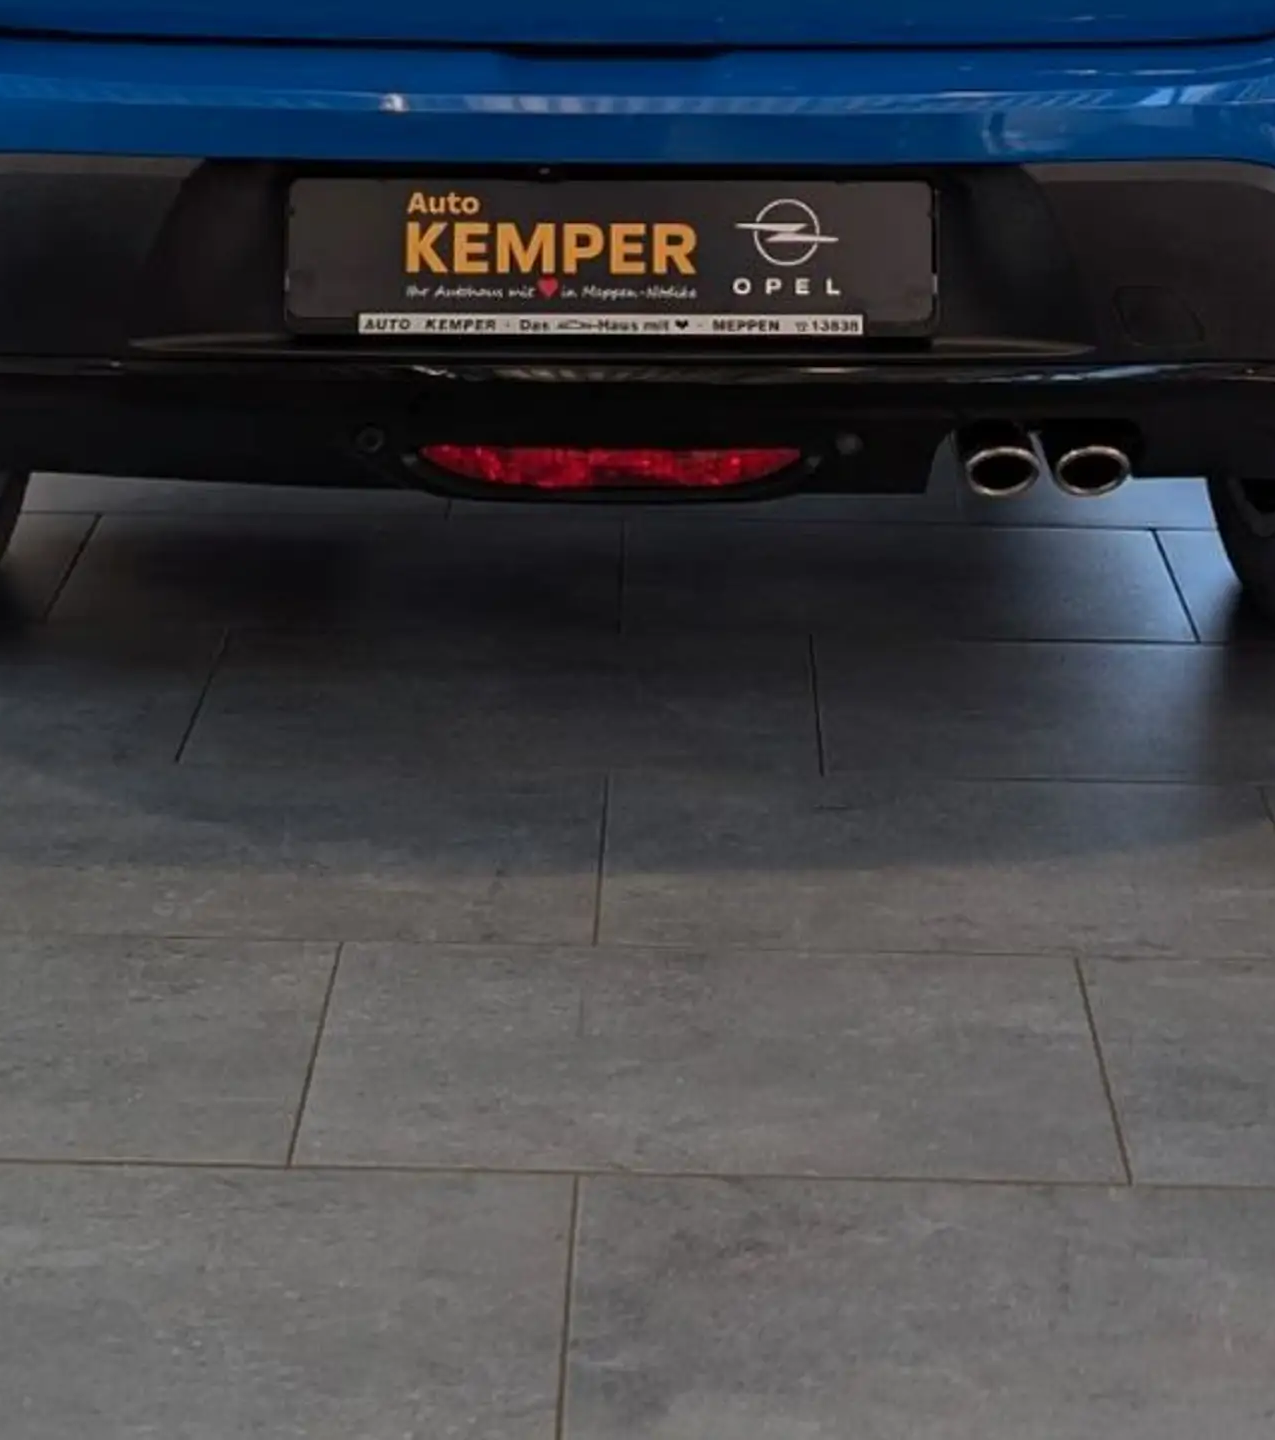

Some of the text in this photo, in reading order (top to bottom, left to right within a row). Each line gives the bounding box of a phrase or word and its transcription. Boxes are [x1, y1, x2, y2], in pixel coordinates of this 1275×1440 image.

[407, 191, 481, 214] Auto
[405, 221, 698, 275] KEMPER
[434, 284, 504, 299] Autohaus
[508, 285, 536, 299] mit
[560, 285, 578, 299] in
[732, 277, 842, 296] OPEL
[364, 318, 412, 331] AUTO
[425, 318, 497, 331] KEMPER
[519, 319, 549, 331] Das
[643, 319, 670, 332] mit
[712, 319, 780, 332] MEPPEN
